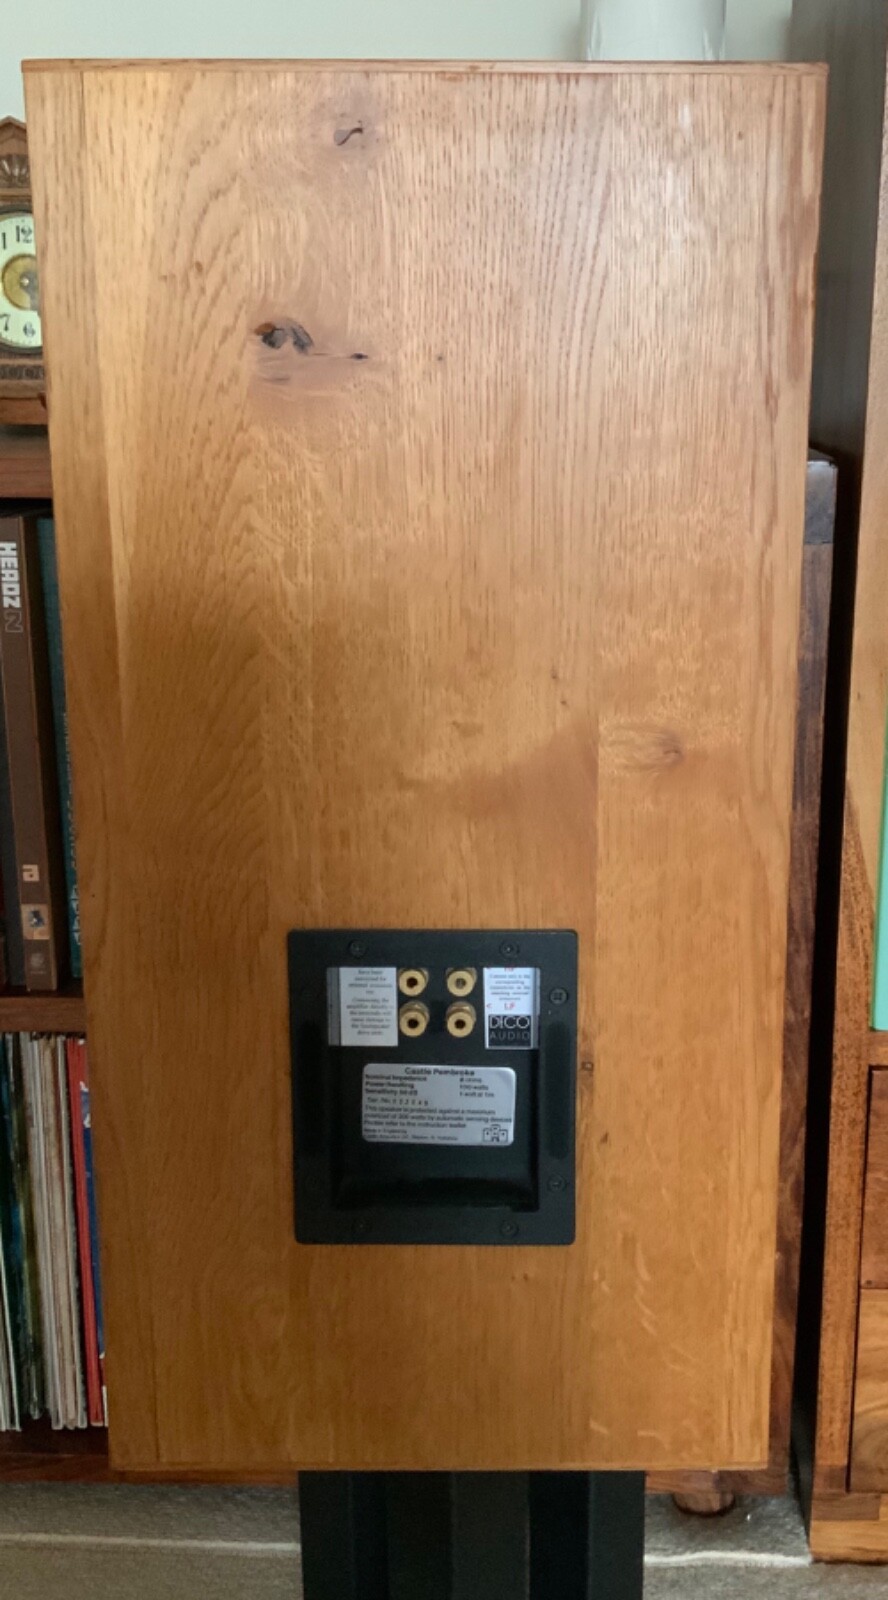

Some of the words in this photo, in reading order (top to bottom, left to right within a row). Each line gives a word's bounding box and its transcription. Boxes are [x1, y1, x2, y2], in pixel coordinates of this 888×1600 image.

[15, 224, 33, 244] 12
[22, 321, 37, 338] 6
[0, 541, 21, 608] HEADZ
[490, 1015, 530, 1029] DICO
[490, 1030, 530, 1042] AUDIO
[404, 1067, 432, 1075] Castle
[433, 1067, 475, 1077] Pembroke
